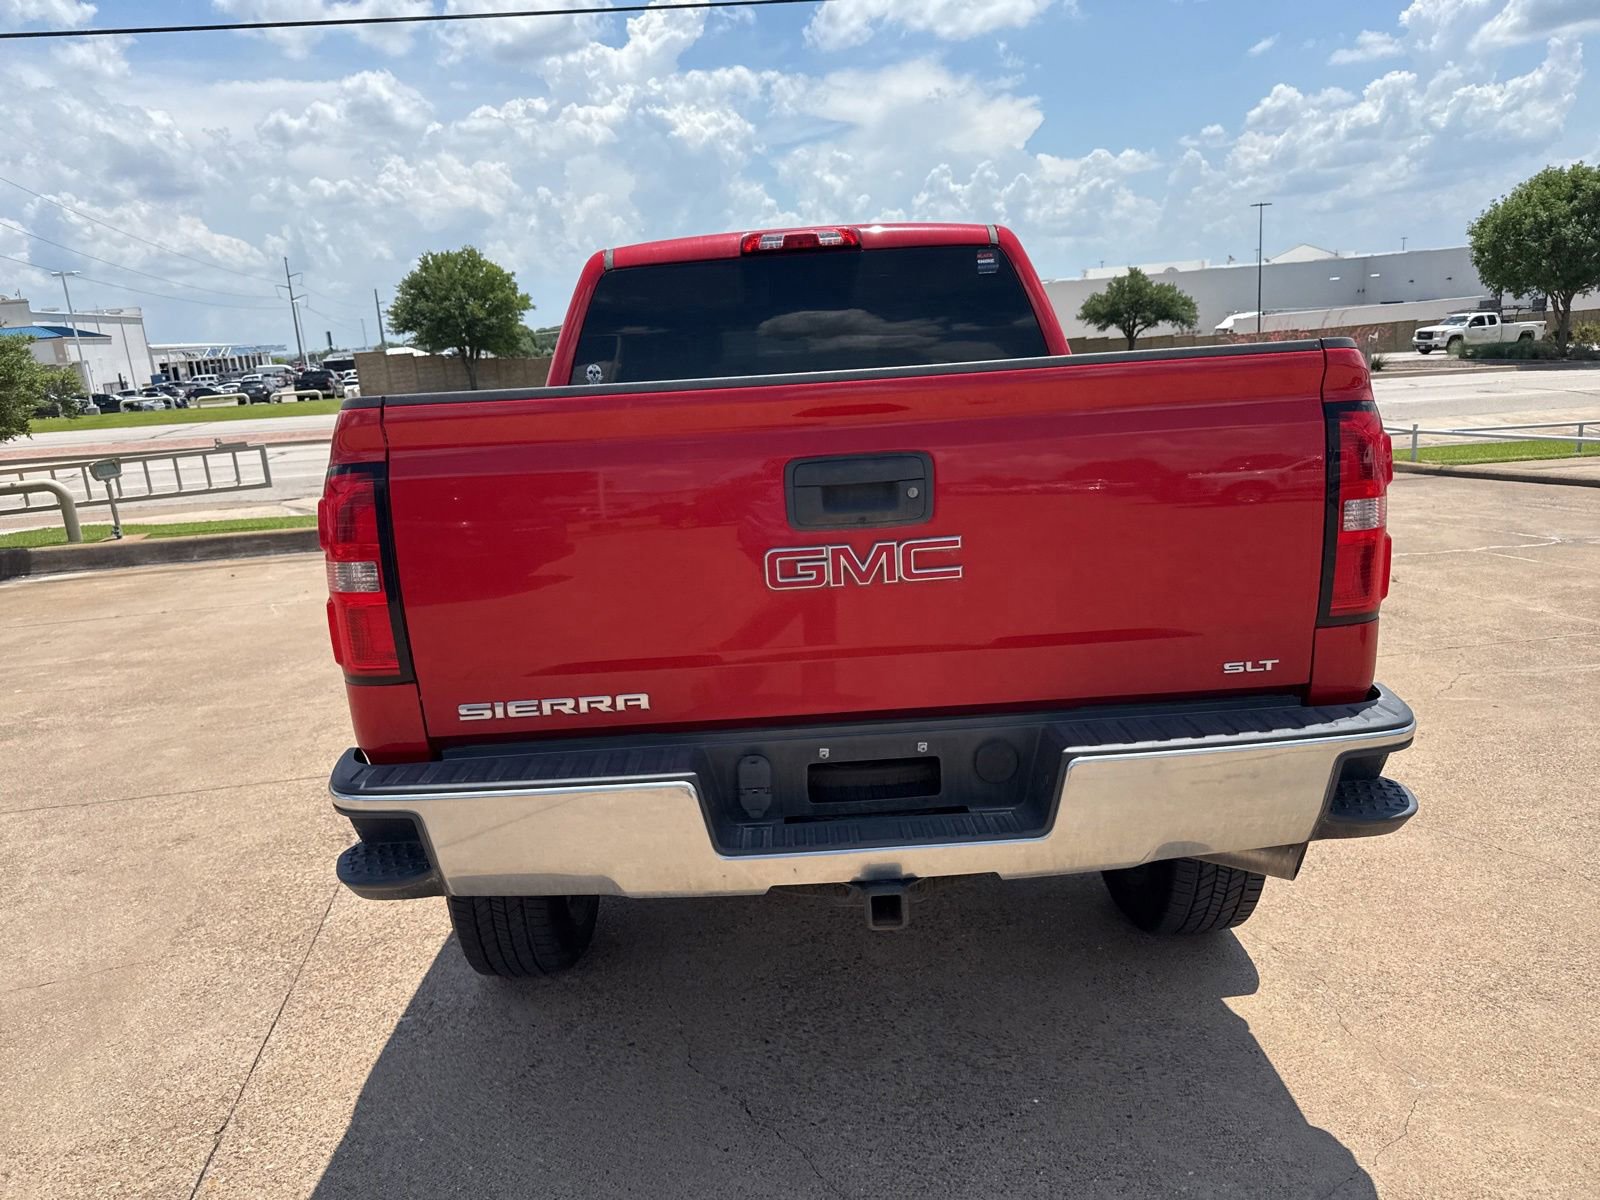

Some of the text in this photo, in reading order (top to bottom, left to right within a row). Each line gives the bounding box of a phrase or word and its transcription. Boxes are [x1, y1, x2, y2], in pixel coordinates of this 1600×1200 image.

[764, 535, 963, 591] GMC
[1223, 659, 1280, 674] SLT
[458, 693, 650, 721] SIERRA
